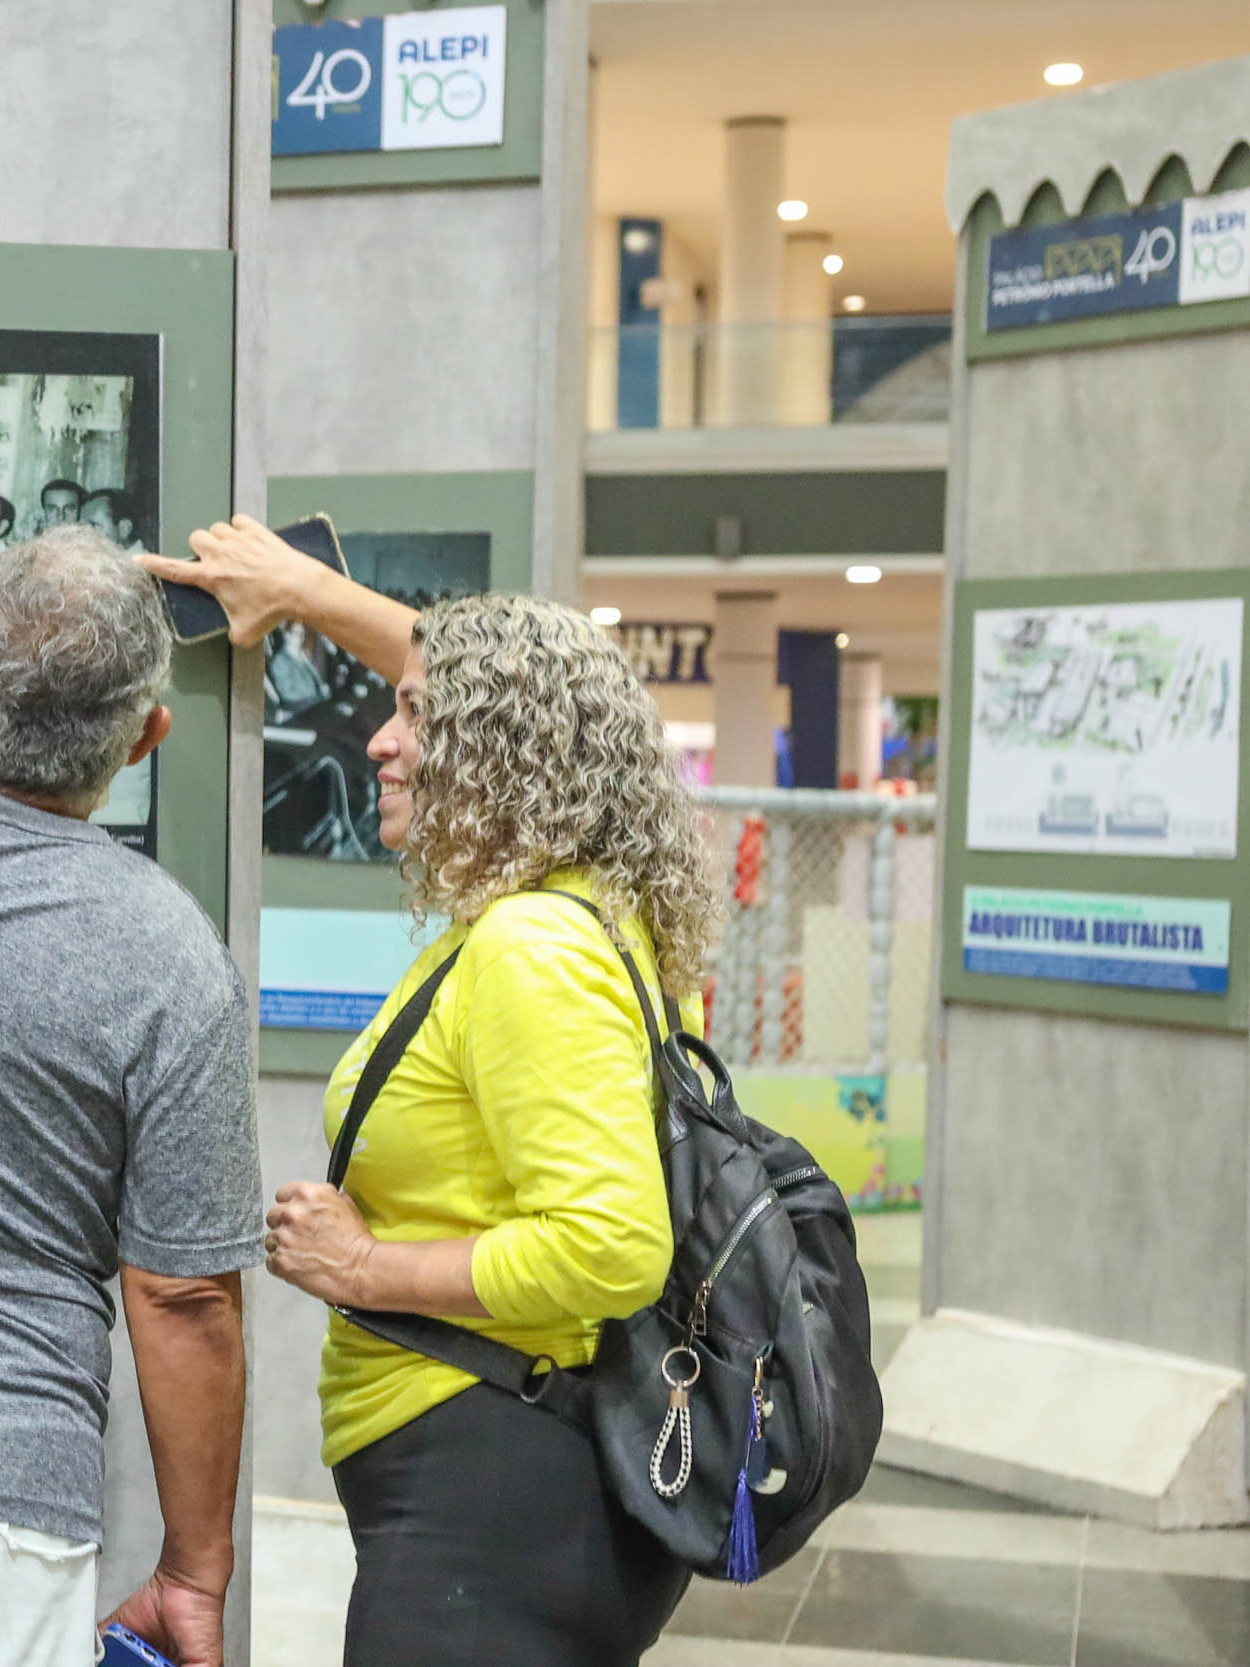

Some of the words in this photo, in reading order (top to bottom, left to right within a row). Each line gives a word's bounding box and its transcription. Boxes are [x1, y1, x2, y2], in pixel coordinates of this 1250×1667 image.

[398, 34, 488, 63] ALEPI
[286, 49, 372, 120] 40
[398, 69, 487, 124] 190
[1191, 210, 1246, 236] ALEPI
[1124, 226, 1176, 285] 40
[1093, 918, 1203, 951] BRUTALISTA
